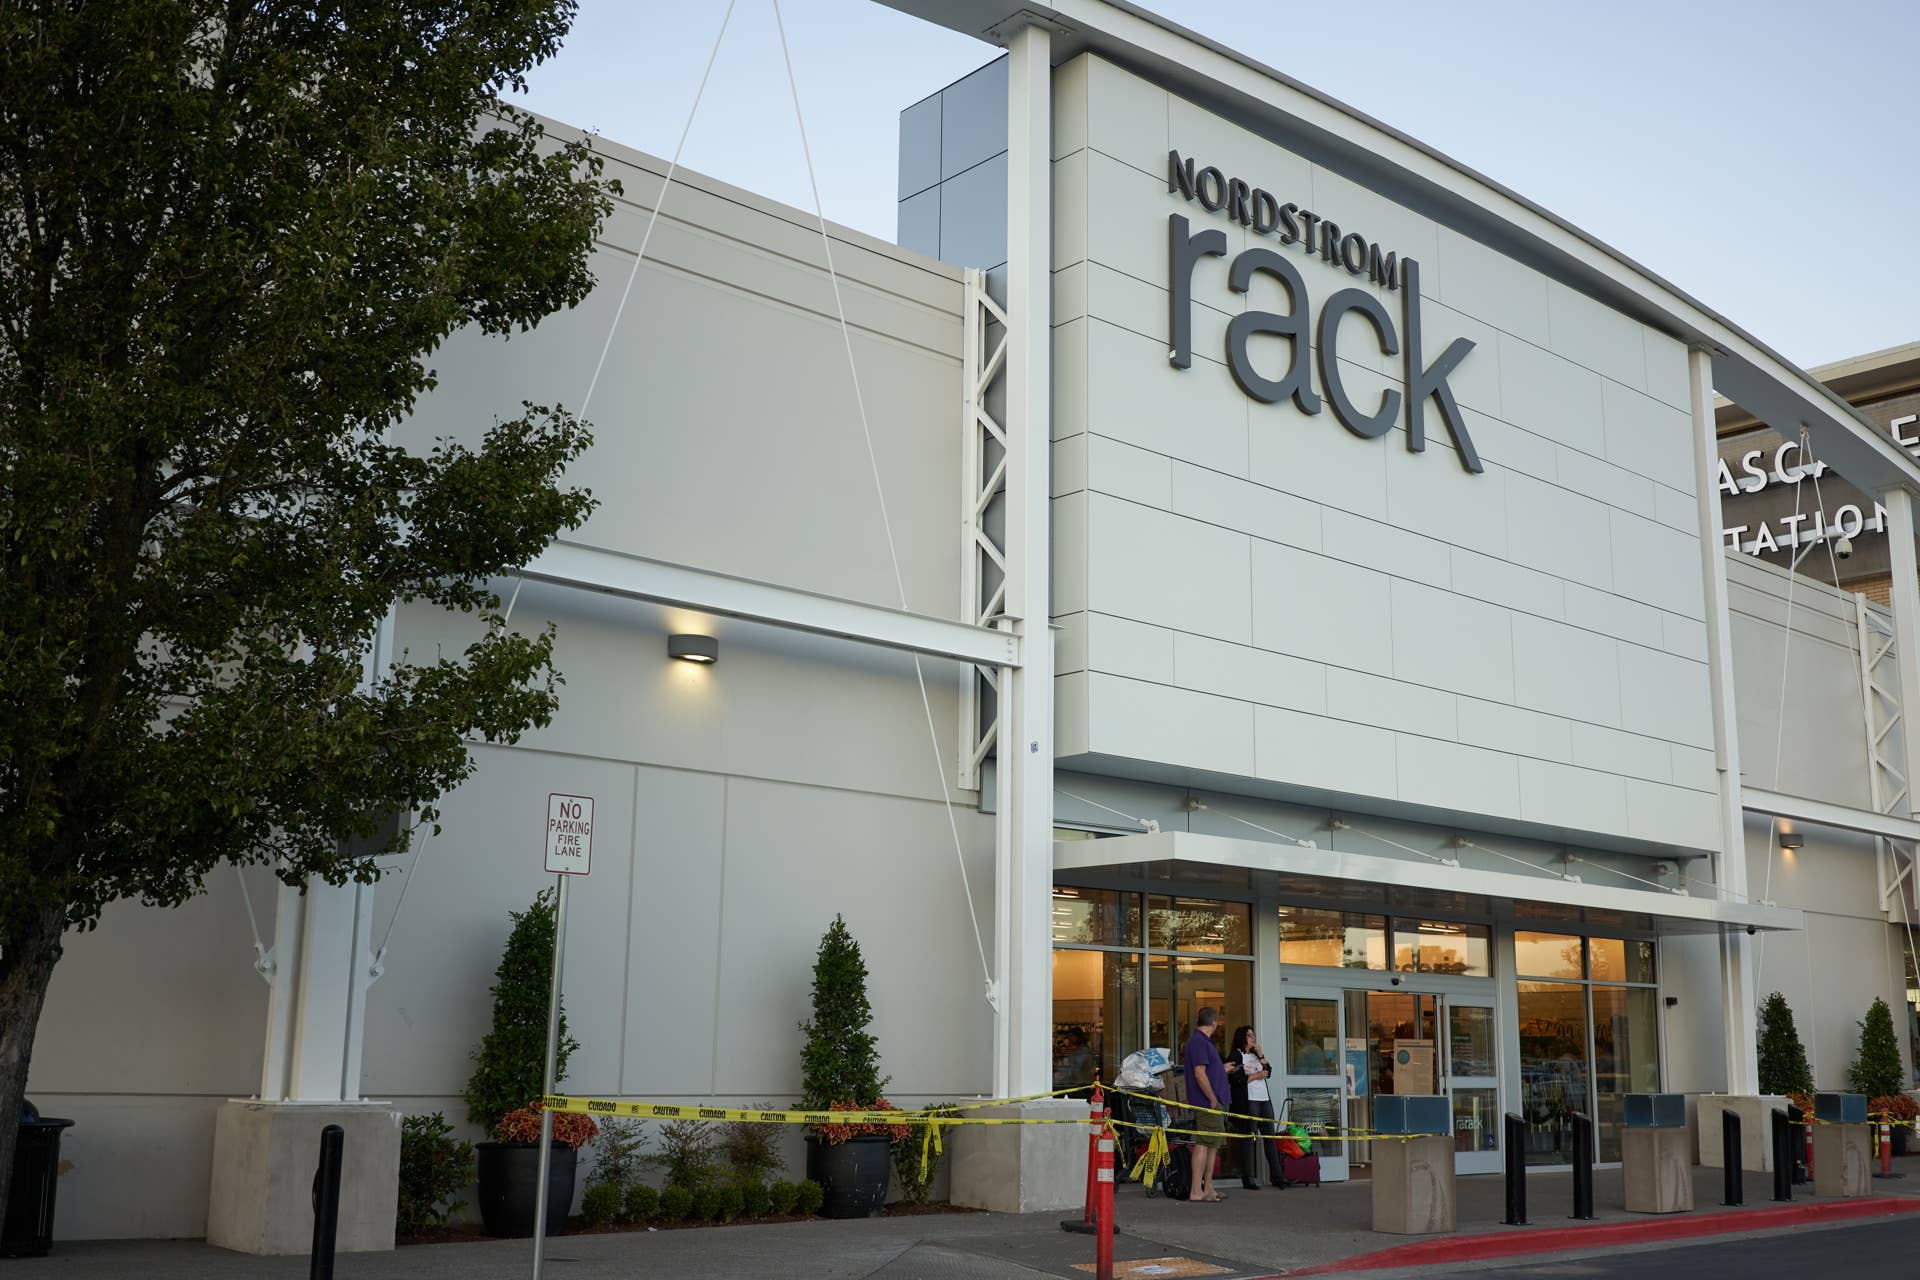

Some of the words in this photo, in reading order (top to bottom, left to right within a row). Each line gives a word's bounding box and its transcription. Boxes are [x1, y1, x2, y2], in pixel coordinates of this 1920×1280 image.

[1168, 149, 1399, 290] NORDSTROM
[1169, 212, 1484, 474] rack
[560, 802, 581, 819] NO
[550, 819, 590, 835] PARKING
[558, 834, 580, 846] FIRE
[555, 846, 581, 857] LANE
[587, 1100, 617, 1113] CUIDADO
[652, 1105, 680, 1117] CAUTION
[699, 1108, 726, 1119] CUIDADO
[760, 1112, 787, 1121] CAUTION
